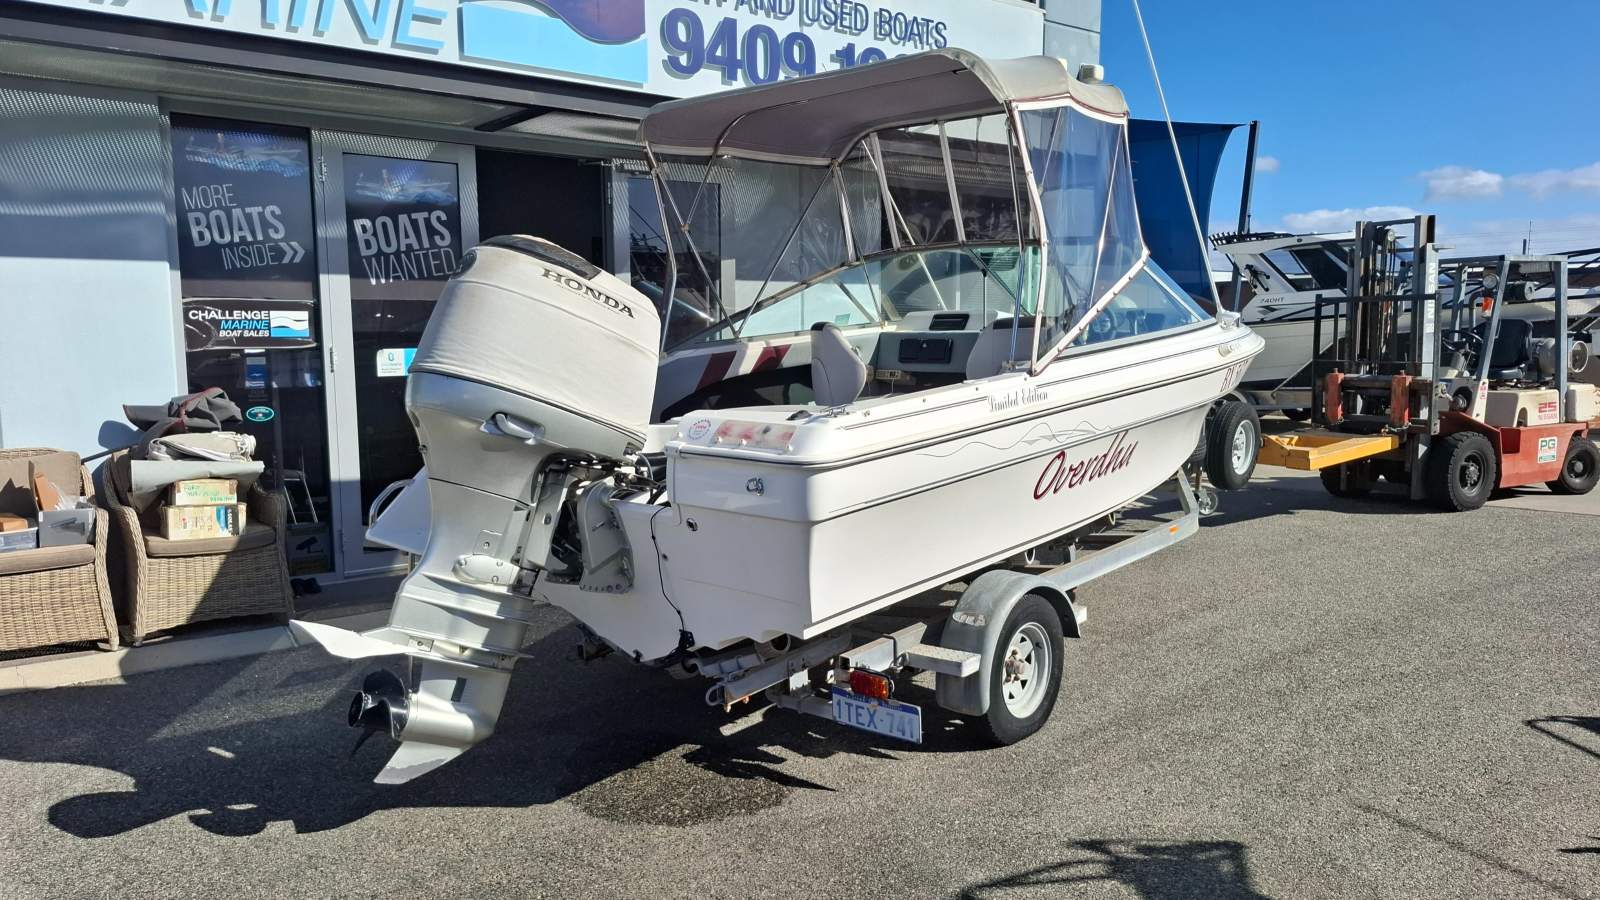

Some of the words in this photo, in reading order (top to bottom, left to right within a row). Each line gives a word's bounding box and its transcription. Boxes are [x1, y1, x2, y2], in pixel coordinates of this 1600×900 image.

[804, 0, 870, 32] USED
[877, 8, 948, 49] BOATS
[661, 7, 817, 87] 9409
[181, 184, 237, 210] MORE
[187, 205, 286, 247] BOATS
[353, 210, 452, 256] BOATS
[221, 243, 279, 271] INSIDE
[361, 248, 457, 286] WANTED
[542, 270, 634, 318] HONDA
[188, 310, 270, 320] CHALLENGE
[220, 320, 270, 330] MARINE
[987, 391, 1019, 412] Limited
[1021, 387, 1048, 405] Edition
[1538, 401, 1557, 413] 25
[1540, 440, 1556, 449] PG
[1033, 430, 1138, 500] Overdhu
